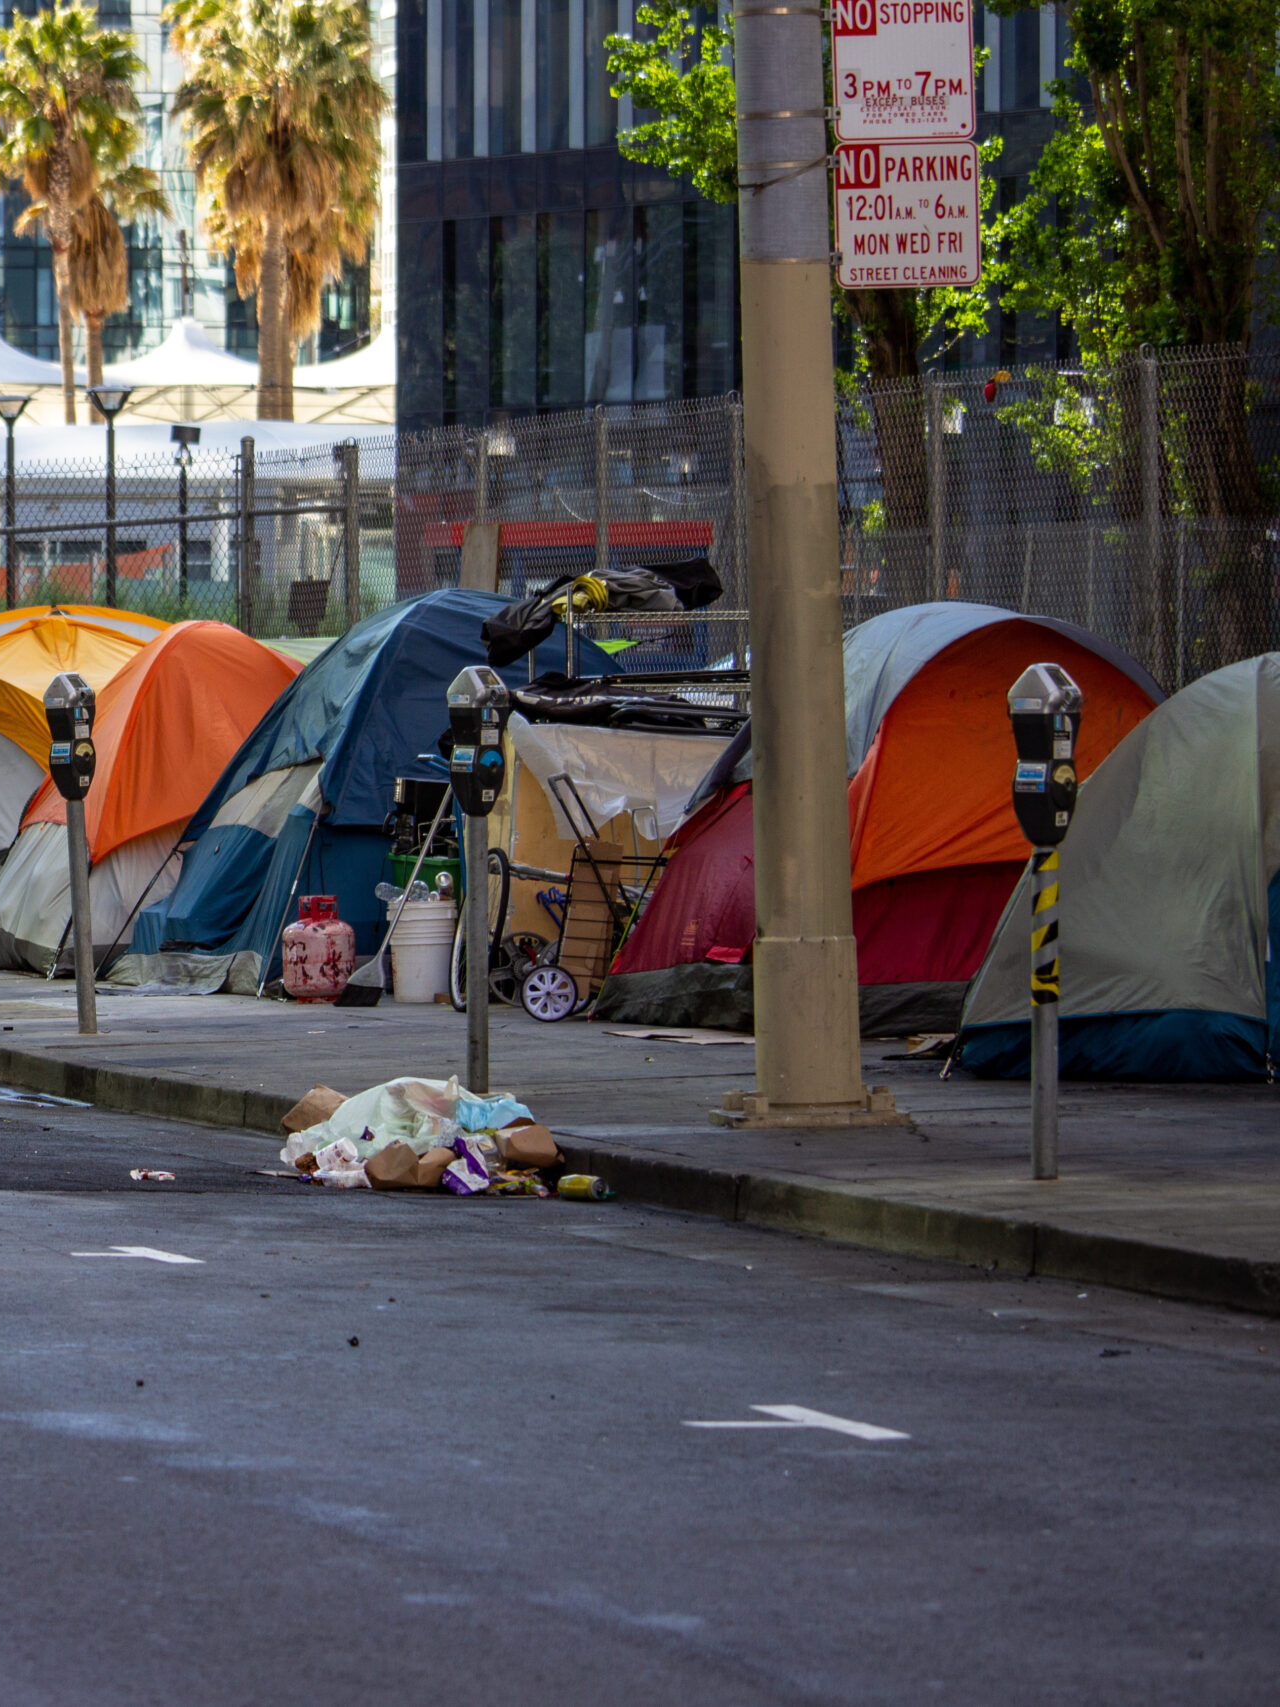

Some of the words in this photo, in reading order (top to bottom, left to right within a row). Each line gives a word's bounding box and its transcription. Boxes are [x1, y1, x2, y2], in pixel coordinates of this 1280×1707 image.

[836, 0, 873, 30] NO
[879, 2, 964, 25] STOPPING
[844, 73, 858, 99] 3
[896, 78, 912, 90] TO
[915, 71, 932, 96] 7
[865, 97, 904, 107] EXCEPT
[911, 96, 945, 106] BUSES
[839, 148, 877, 185] NO
[885, 154, 972, 183] PARKING
[919, 199, 929, 209] TO
[854, 234, 889, 256] MON
[896, 233, 930, 255] WED
[938, 232, 963, 254] FRI
[850, 266, 899, 281] STREET
[903, 265, 967, 281] CLEANING
